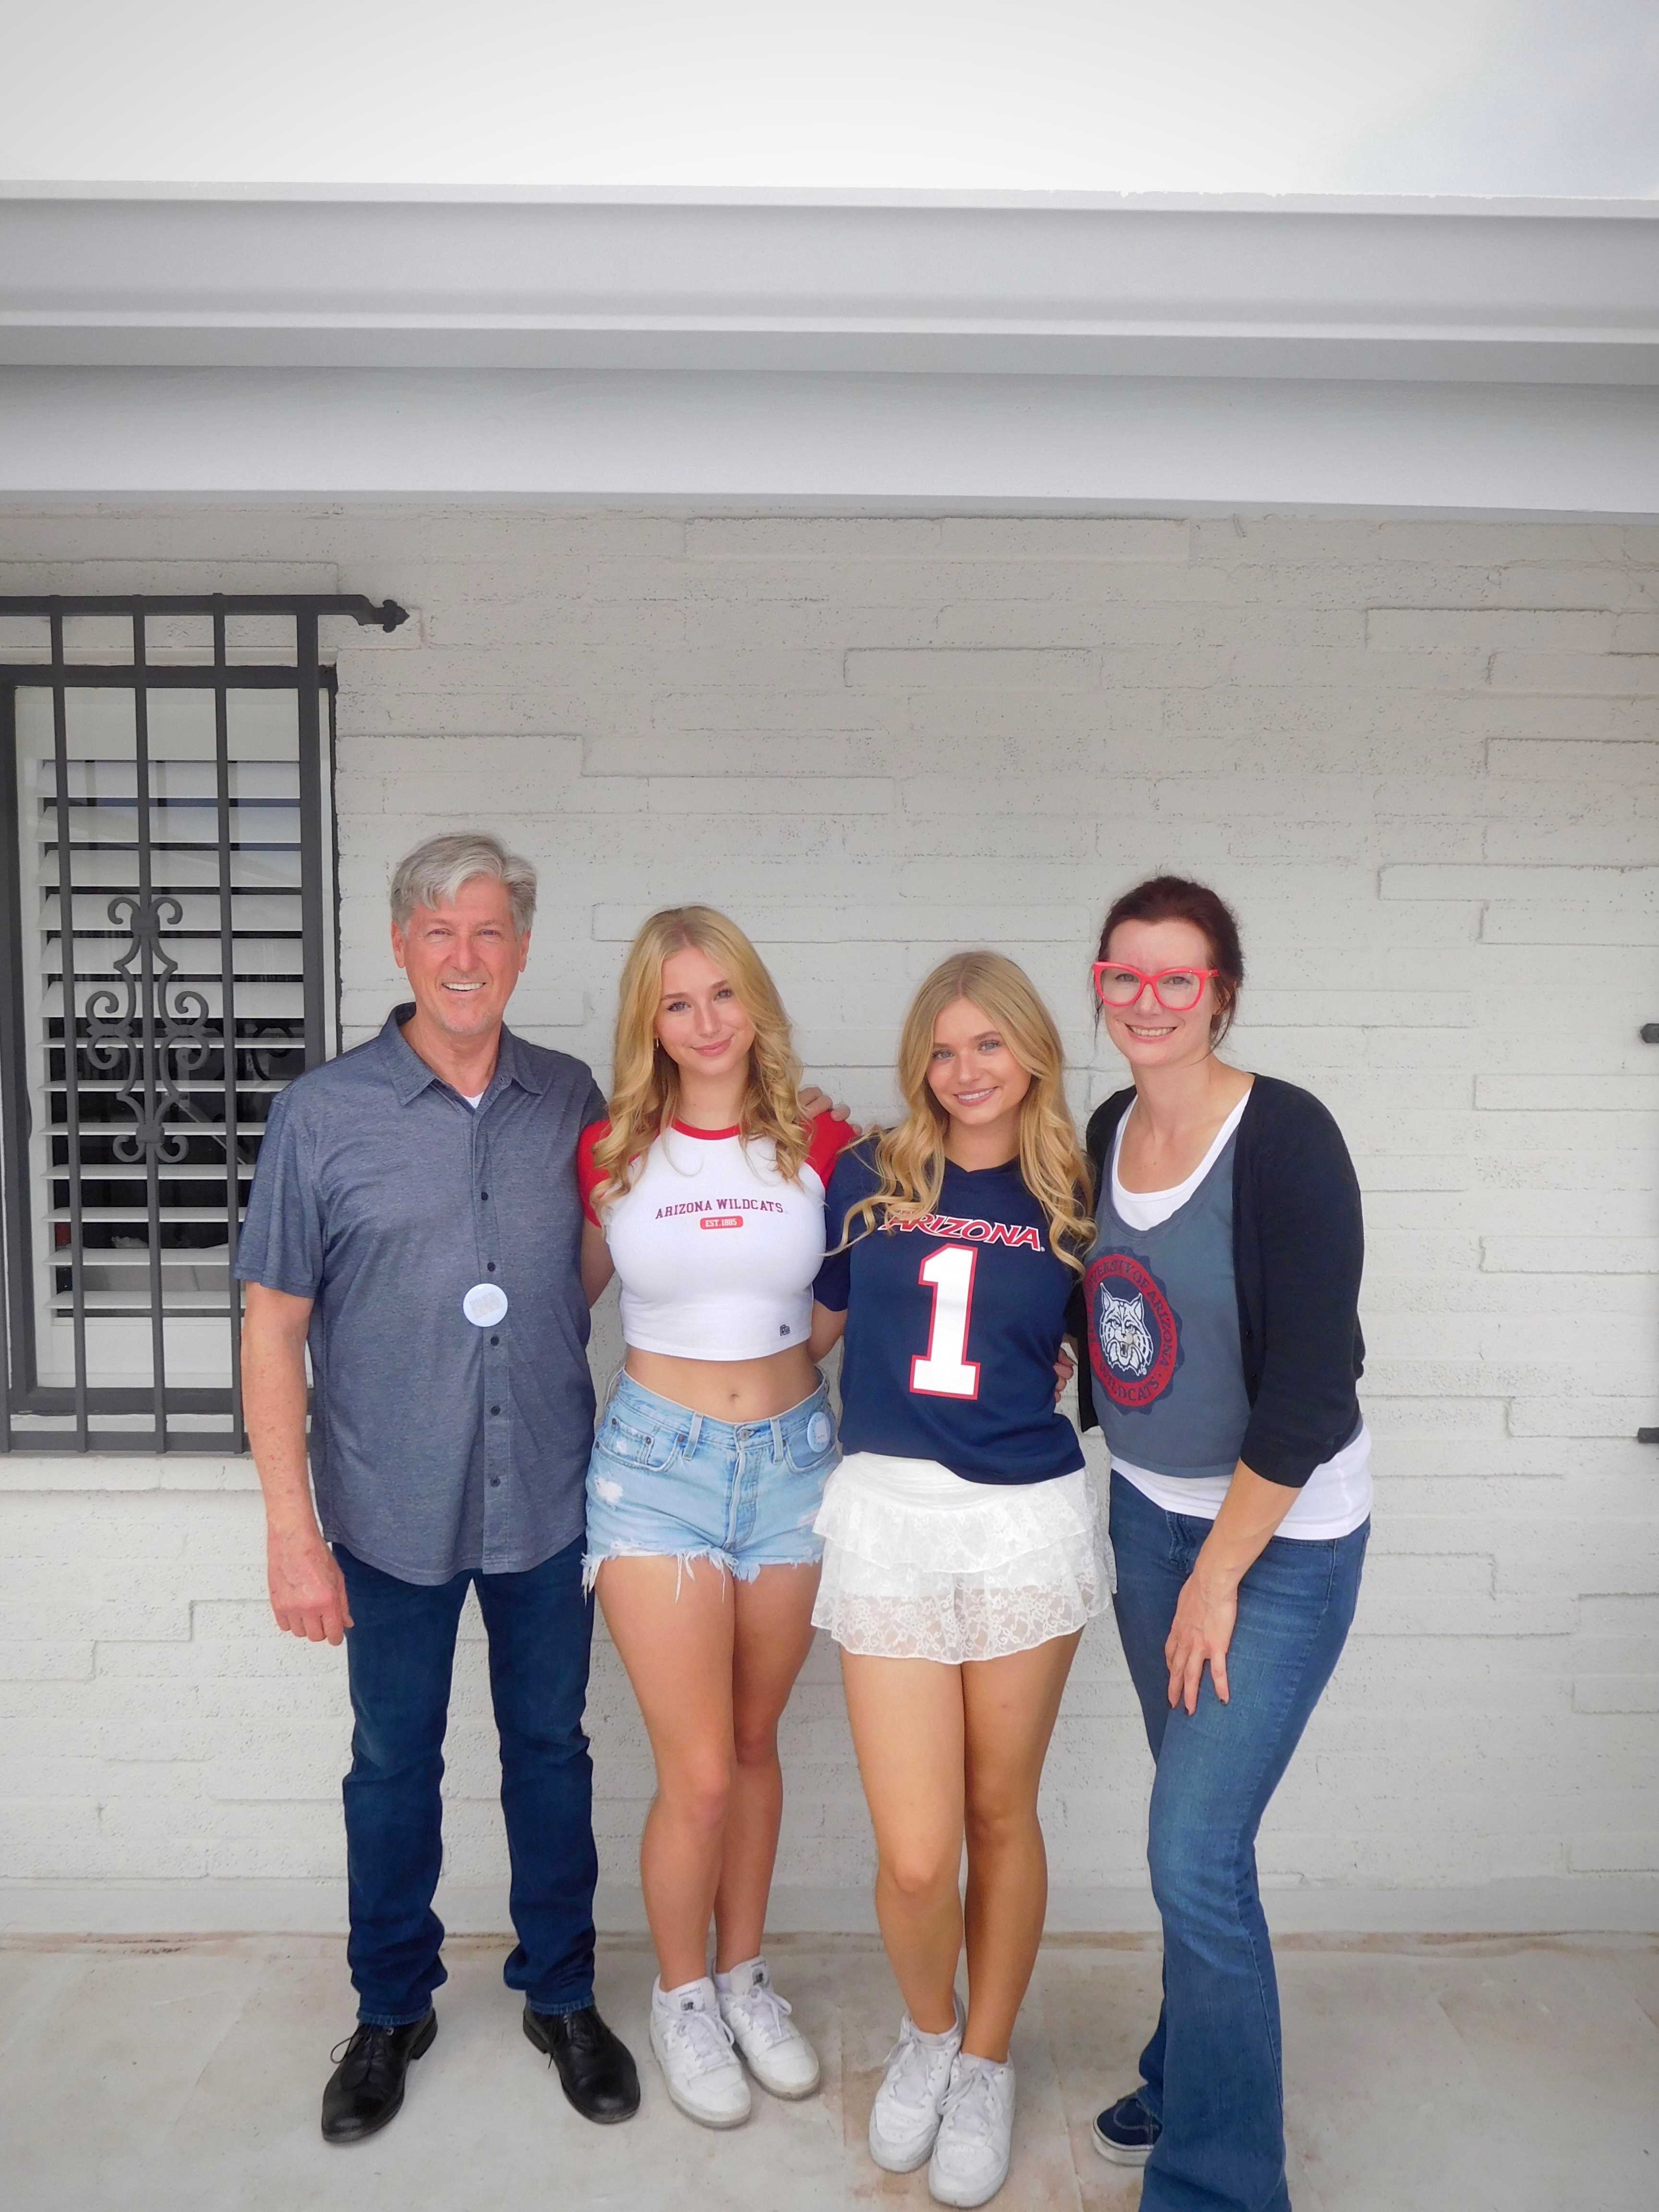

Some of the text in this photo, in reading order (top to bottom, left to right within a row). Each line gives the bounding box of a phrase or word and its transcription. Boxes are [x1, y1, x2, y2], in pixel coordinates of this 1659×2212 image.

[655, 1198, 783, 1219] ARIZONA WILDCATS
[878, 1210, 1041, 1251] ARIZONA
[910, 1243, 981, 1400] 1
[1132, 1270, 1149, 1288] OF
[1147, 1290, 1173, 1367] ARIZONA
[1099, 1359, 1160, 1401] WILDCATS
